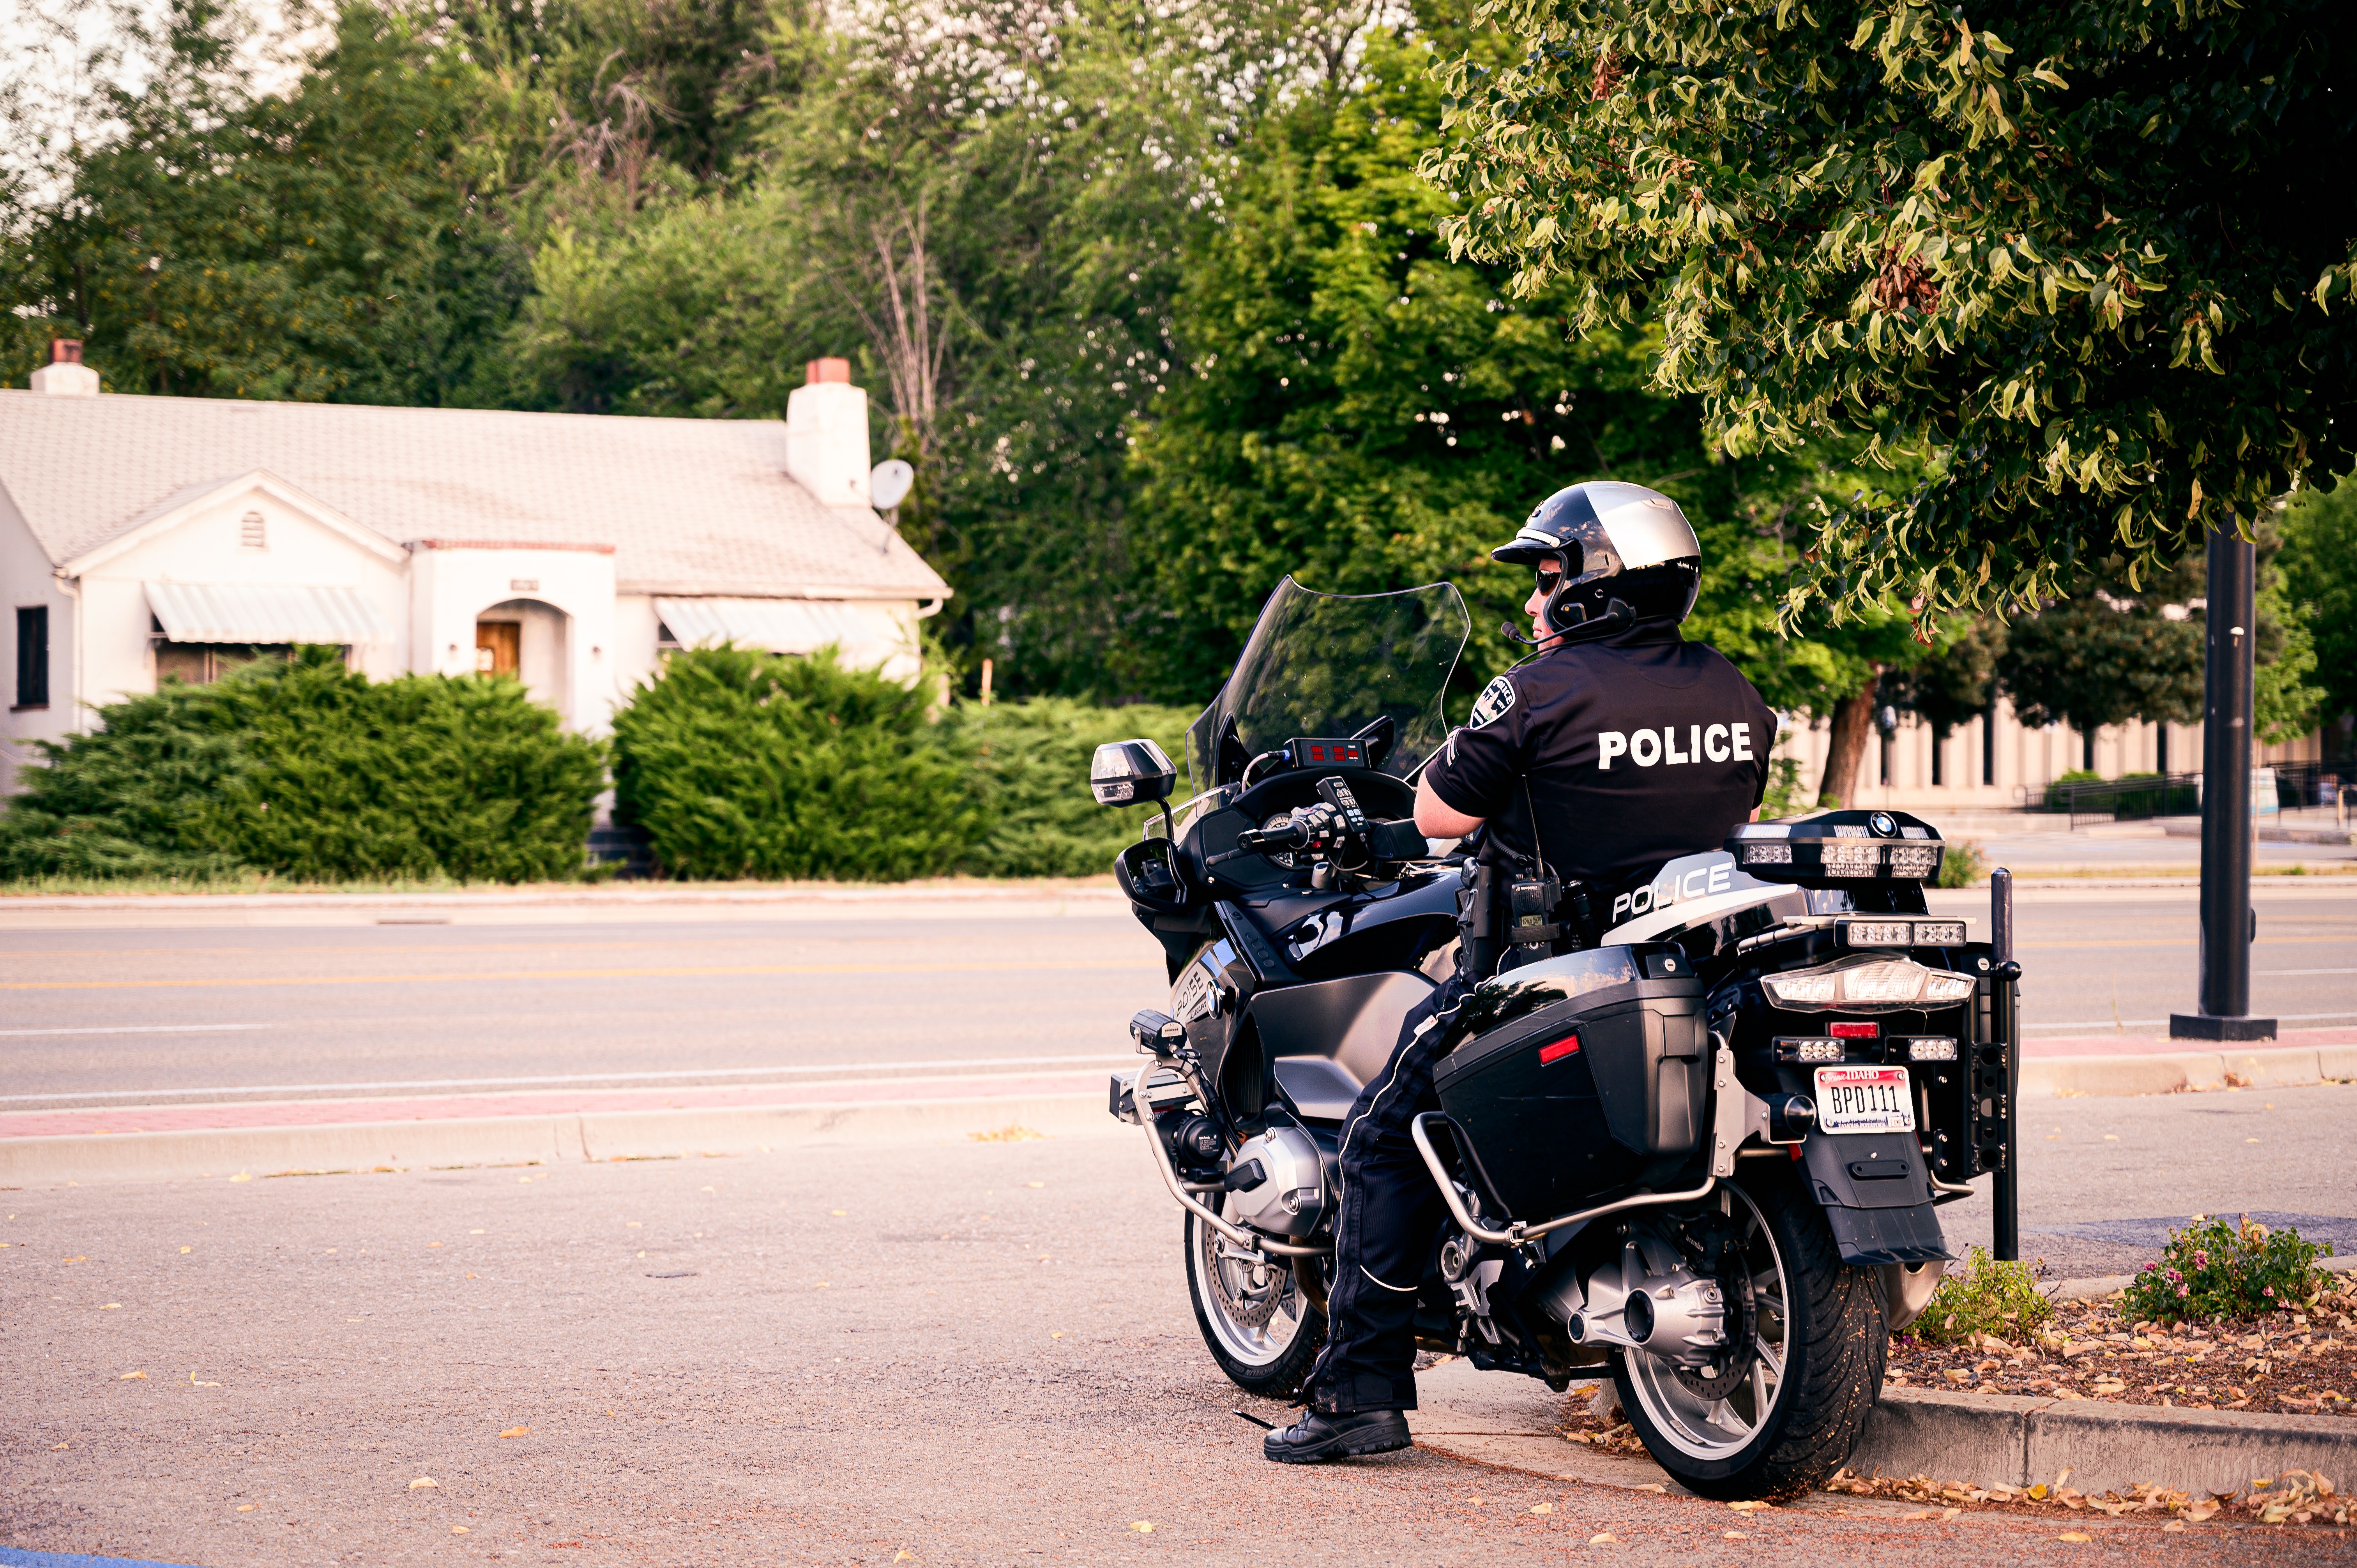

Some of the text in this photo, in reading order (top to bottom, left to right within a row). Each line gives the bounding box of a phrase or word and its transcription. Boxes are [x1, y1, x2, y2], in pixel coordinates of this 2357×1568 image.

[1493, 680, 1512, 705] POLICE
[1598, 722, 1753, 770] POLICE
[1612, 862, 1733, 923] POLICE
[1177, 971, 1204, 1017] BOISE
[1845, 1070, 1879, 1080] IDAHO
[1831, 1085, 1900, 1114] BPD111
[1686, 1234, 1703, 1252] brembo
